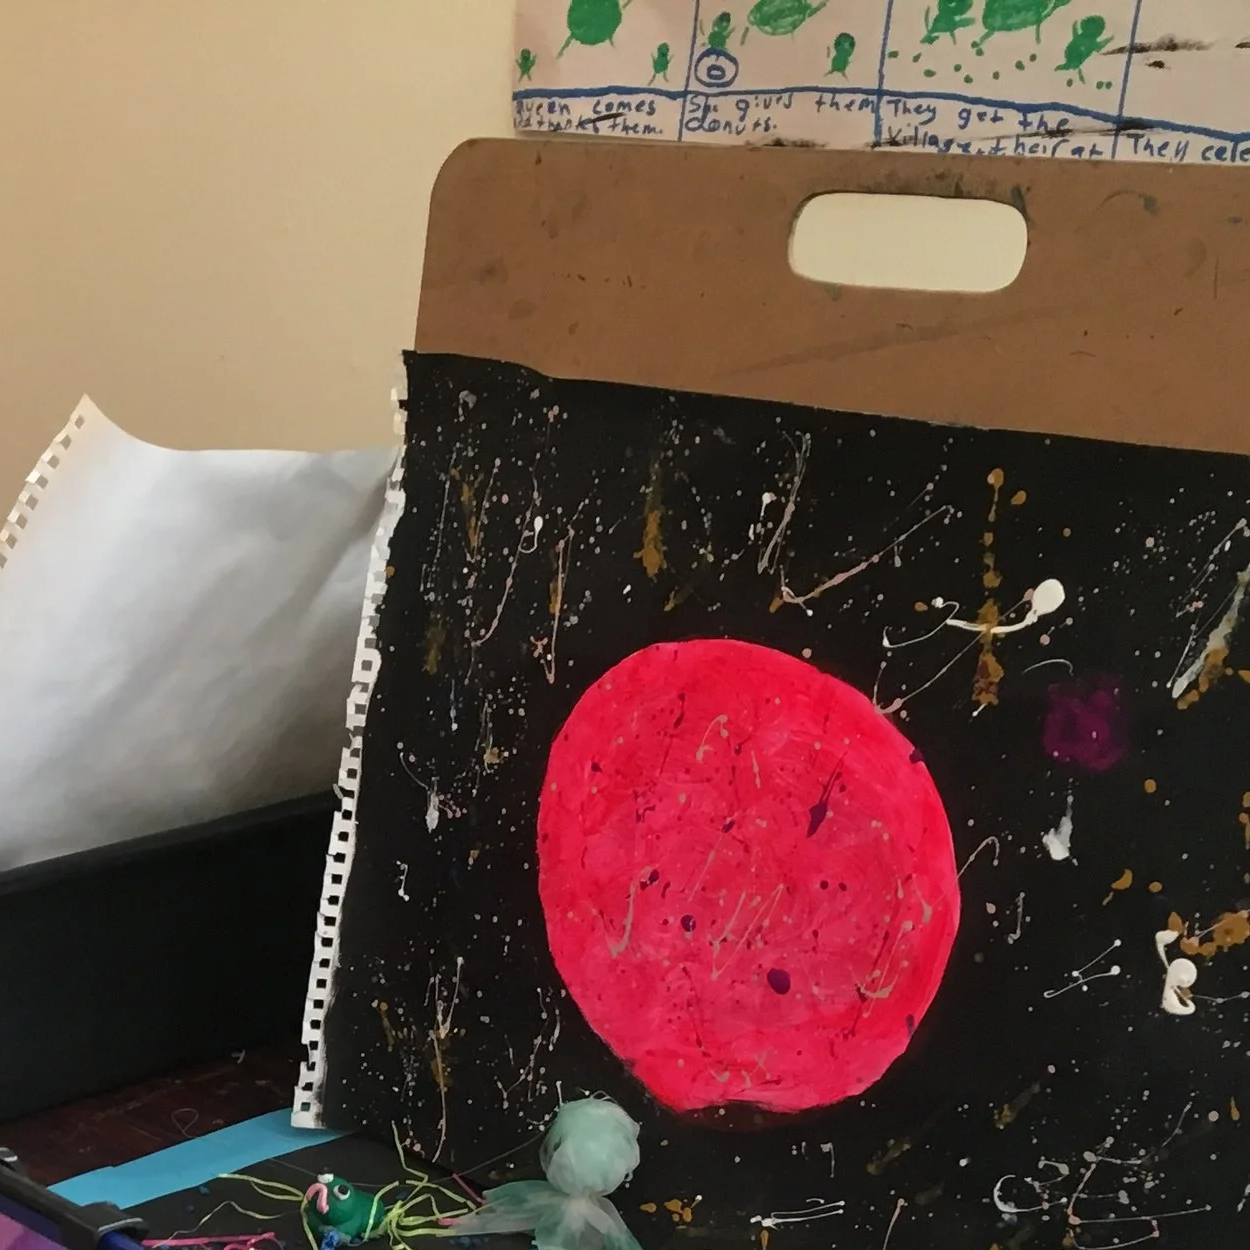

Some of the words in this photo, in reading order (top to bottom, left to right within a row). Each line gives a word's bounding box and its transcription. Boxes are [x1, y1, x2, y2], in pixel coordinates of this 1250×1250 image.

[815, 93, 876, 113] them
[887, 98, 937, 125] They
[957, 108, 1003, 130] get
